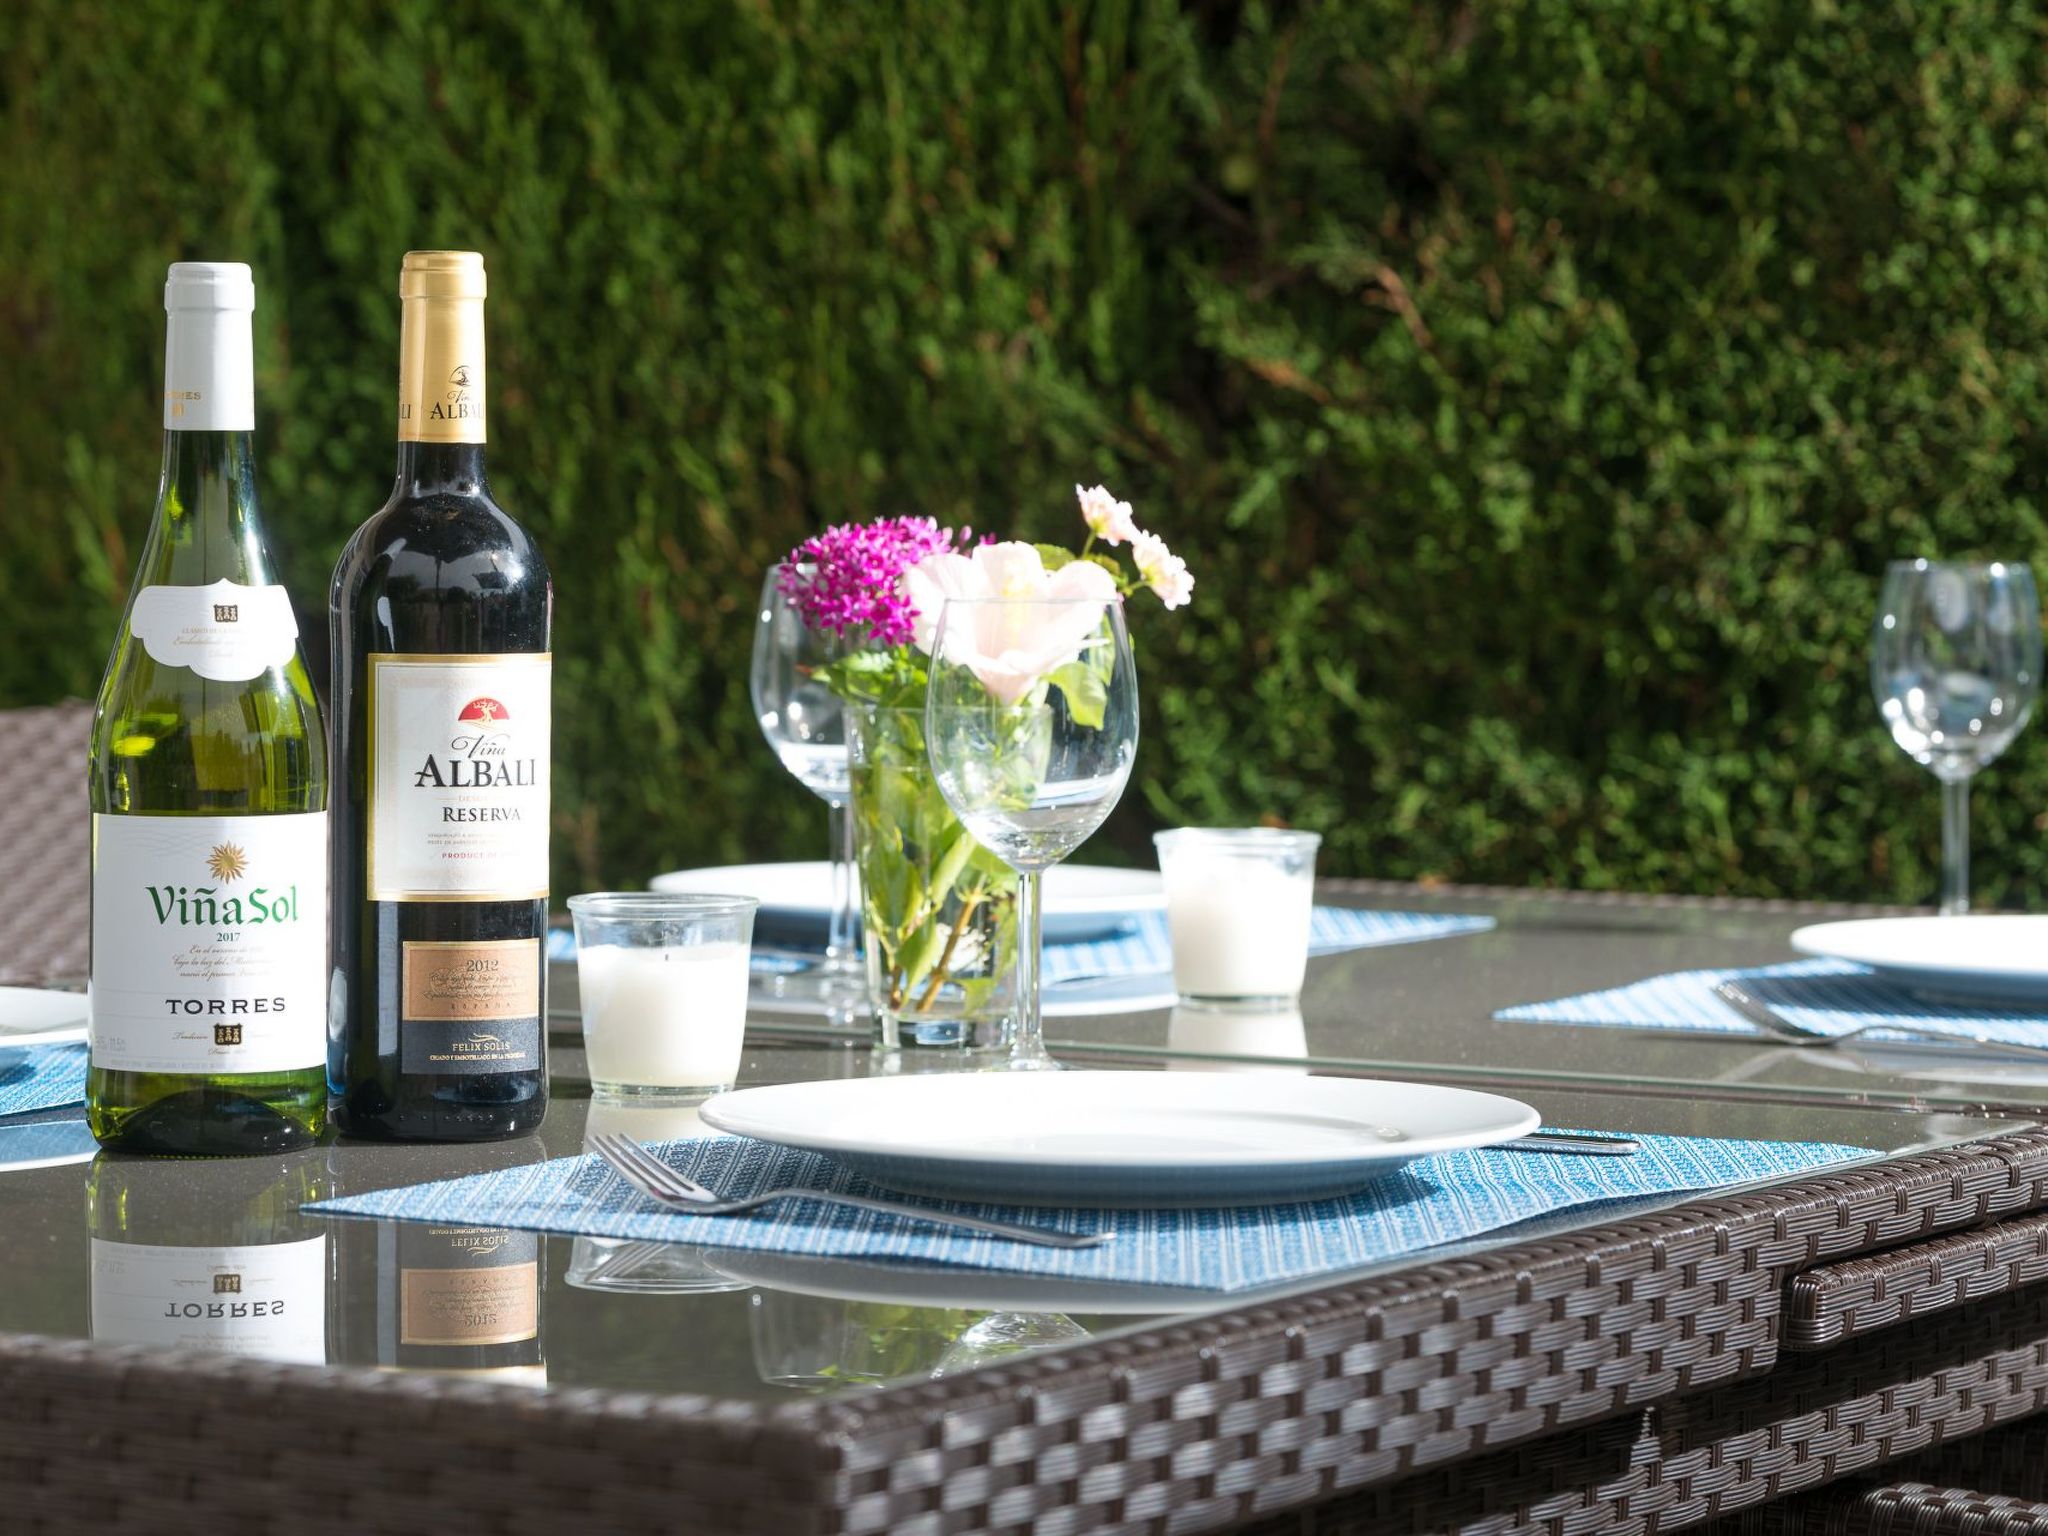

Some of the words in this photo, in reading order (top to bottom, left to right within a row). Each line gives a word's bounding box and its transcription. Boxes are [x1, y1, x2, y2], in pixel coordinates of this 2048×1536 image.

[451, 733, 511, 759] Viña
[414, 753, 536, 788] ALBALI
[442, 806, 521, 823] RESERVA
[442, 851, 484, 859] PRODUCT
[145, 885, 244, 926] Viña
[247, 884, 299, 924] Sol
[216, 932, 241, 942] 2017
[466, 959, 499, 972] 2012
[165, 997, 286, 1015] TORRES
[452, 1043, 481, 1052] FELIX
[484, 1041, 511, 1051] SOLIS
